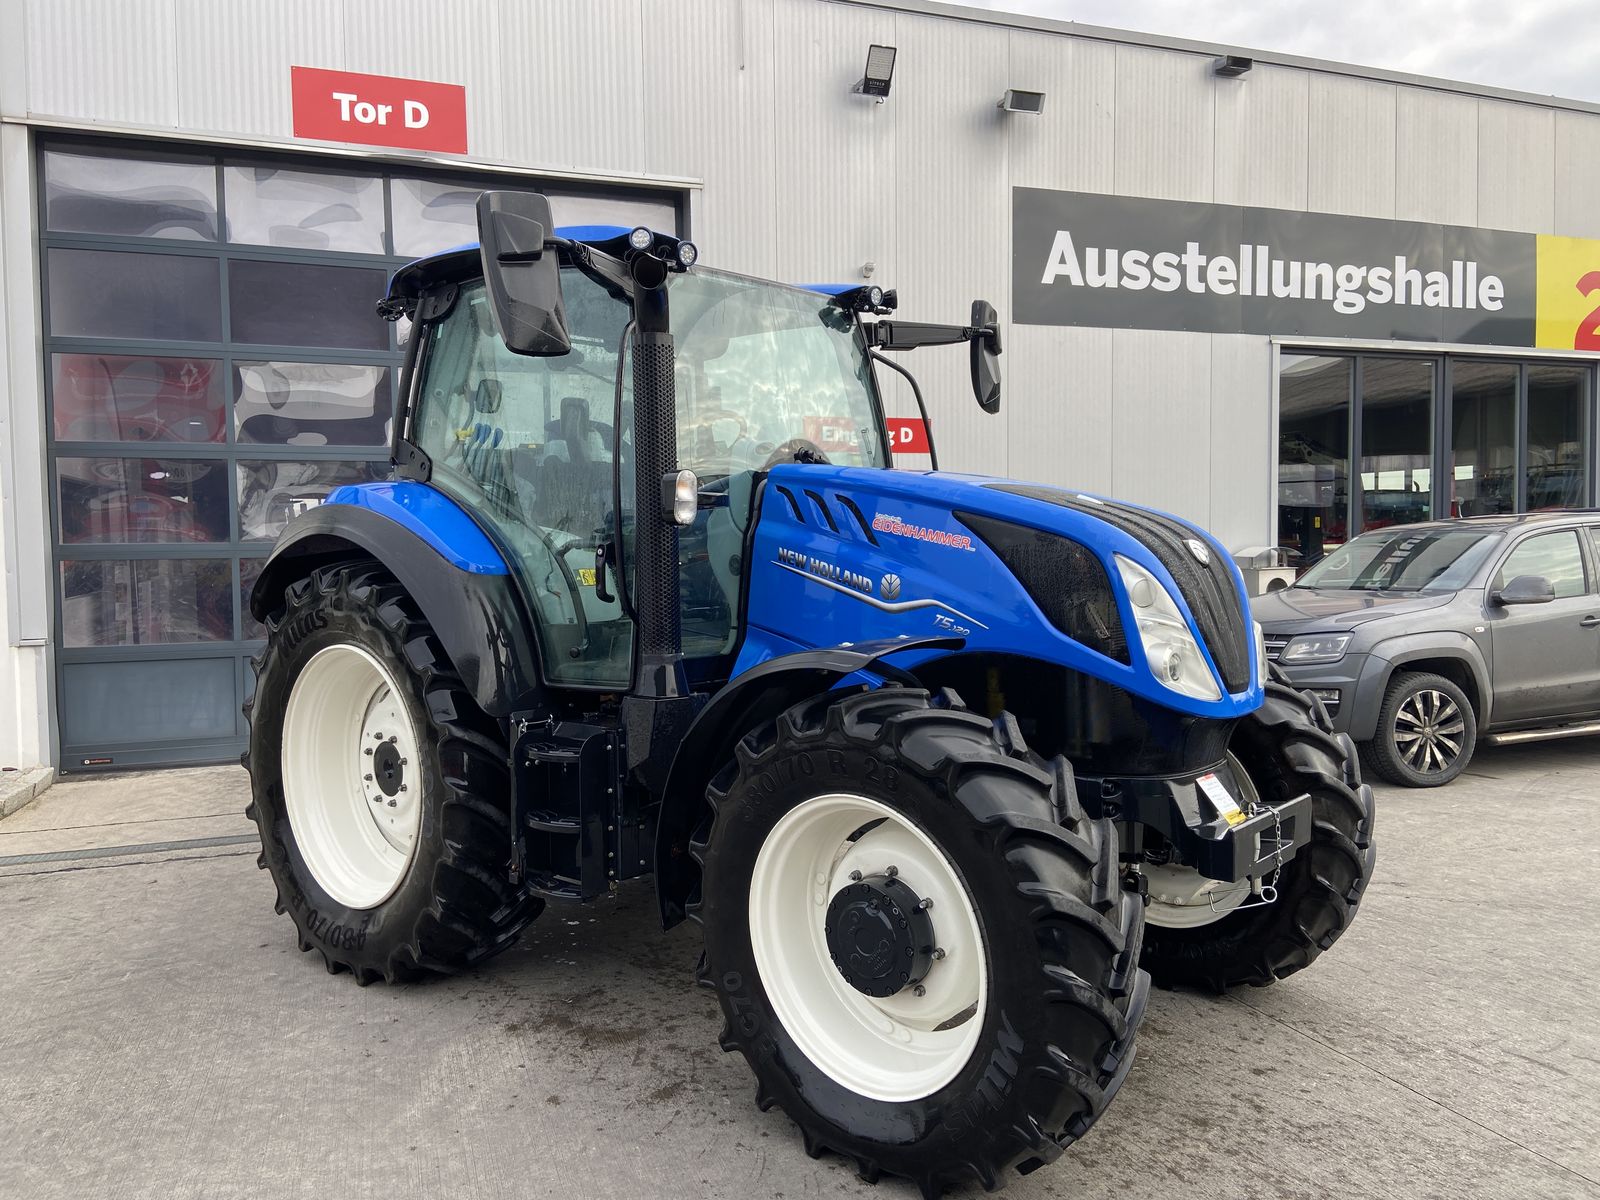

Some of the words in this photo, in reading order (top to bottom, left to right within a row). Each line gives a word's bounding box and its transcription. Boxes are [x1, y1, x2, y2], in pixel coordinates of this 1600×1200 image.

[332, 92, 393, 126] Tor
[404, 100, 430, 129] D
[1041, 230, 1504, 315] Ausstellungshalle
[900, 427, 914, 443] D
[872, 517, 971, 549] EIDENHAMMER
[778, 547, 807, 569] NEW
[810, 557, 873, 593] HOLLAND
